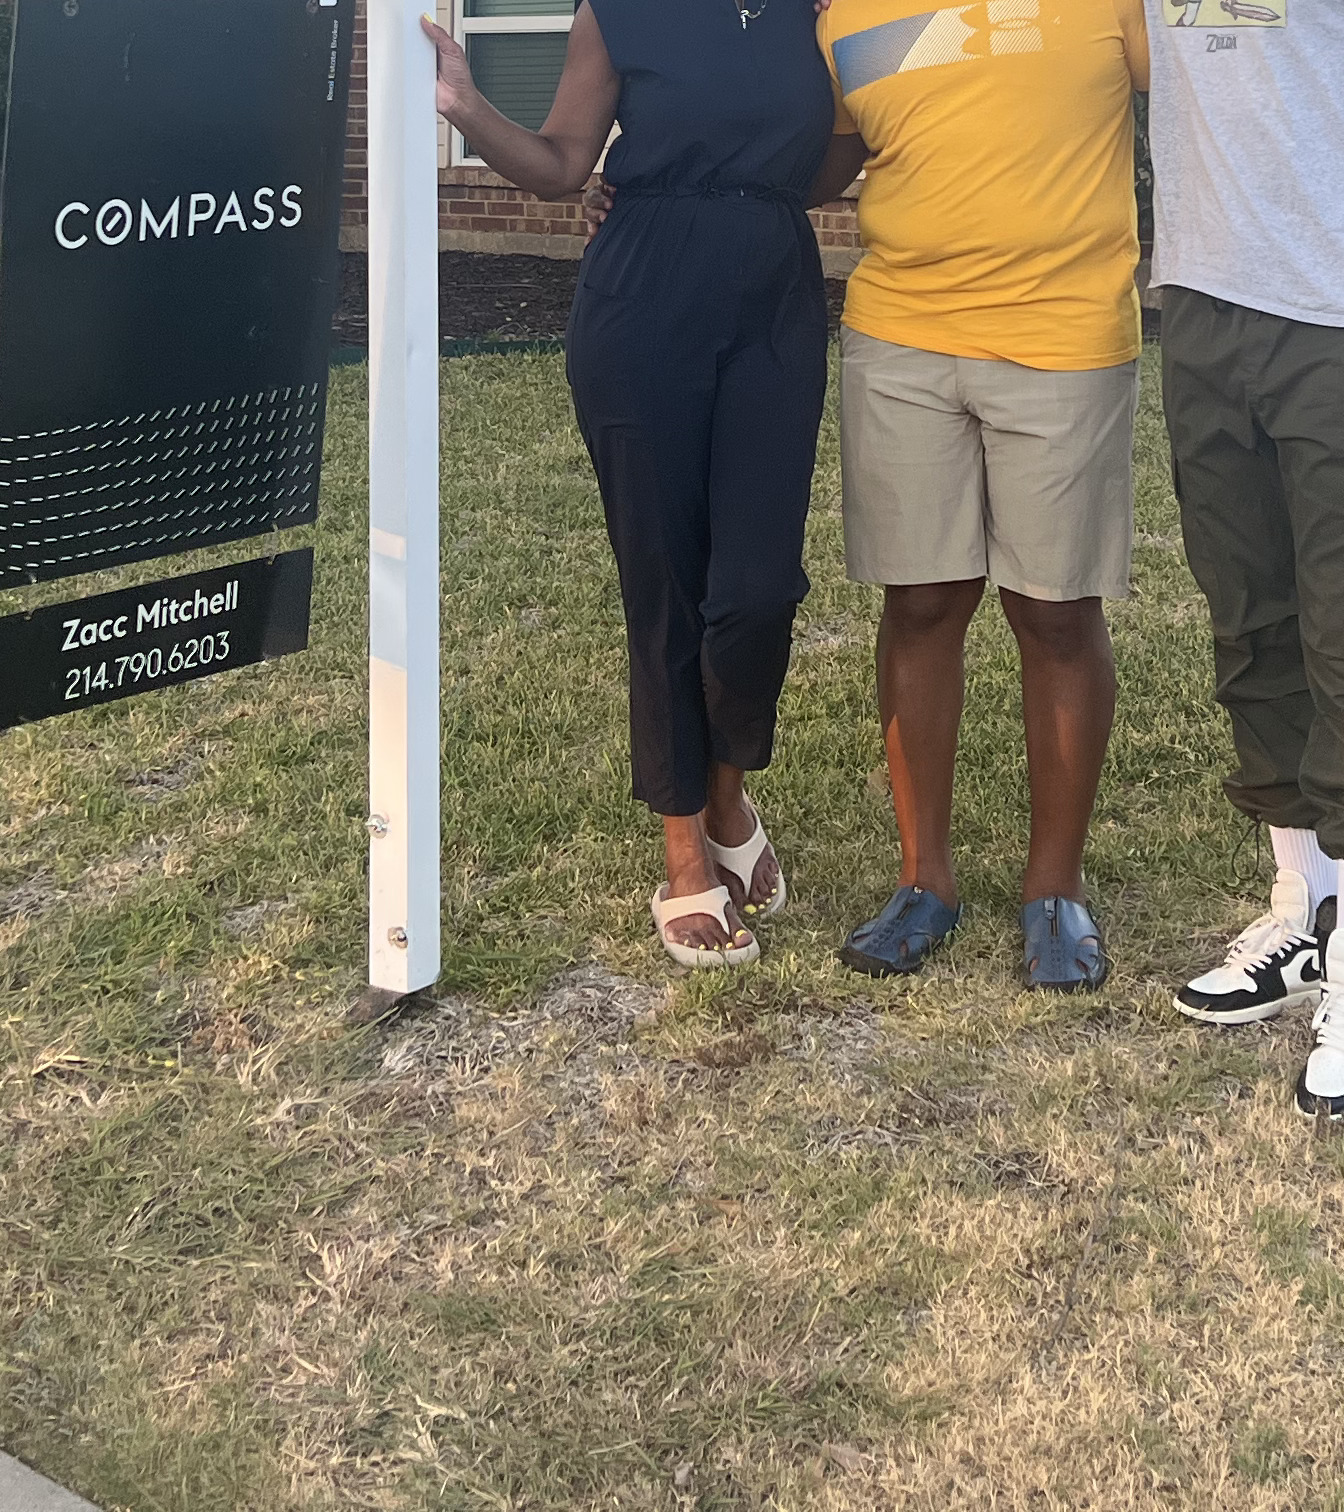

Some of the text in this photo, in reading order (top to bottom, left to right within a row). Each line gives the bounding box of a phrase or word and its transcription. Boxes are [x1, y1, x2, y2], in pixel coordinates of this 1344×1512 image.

[328, 50, 336, 79] Estate
[55, 184, 303, 250] COMPASS
[61, 580, 239, 652] Zacc Mitchell
[64, 630, 231, 701] 214.790.6203
